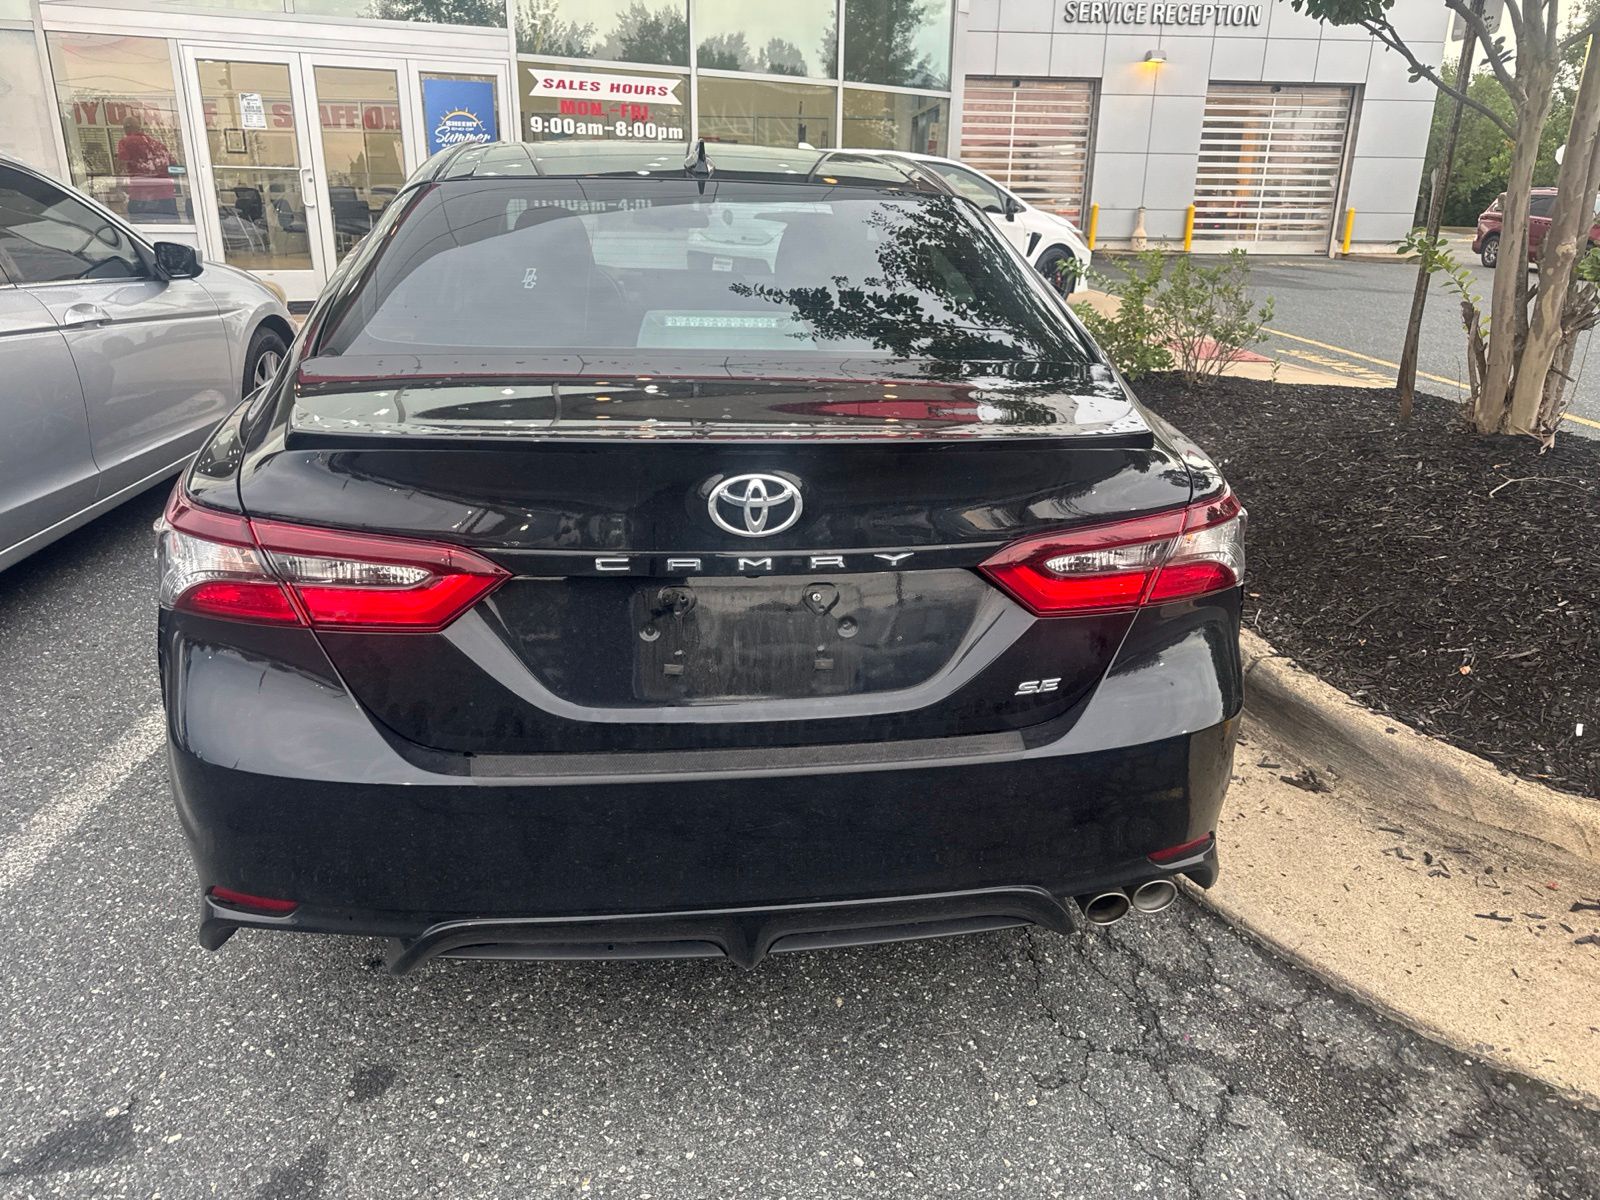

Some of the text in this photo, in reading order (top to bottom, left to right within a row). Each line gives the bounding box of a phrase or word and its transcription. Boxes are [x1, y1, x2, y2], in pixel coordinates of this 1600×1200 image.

[1064, 1, 1263, 26] SERVICE RECEPTION
[543, 78, 669, 96] SALES HOURS
[435, 126, 491, 143] Summer
[530, 116, 684, 140] 9:00am-8:00pm
[595, 552, 915, 571] CAMRY
[1014, 678, 1061, 695] SE
